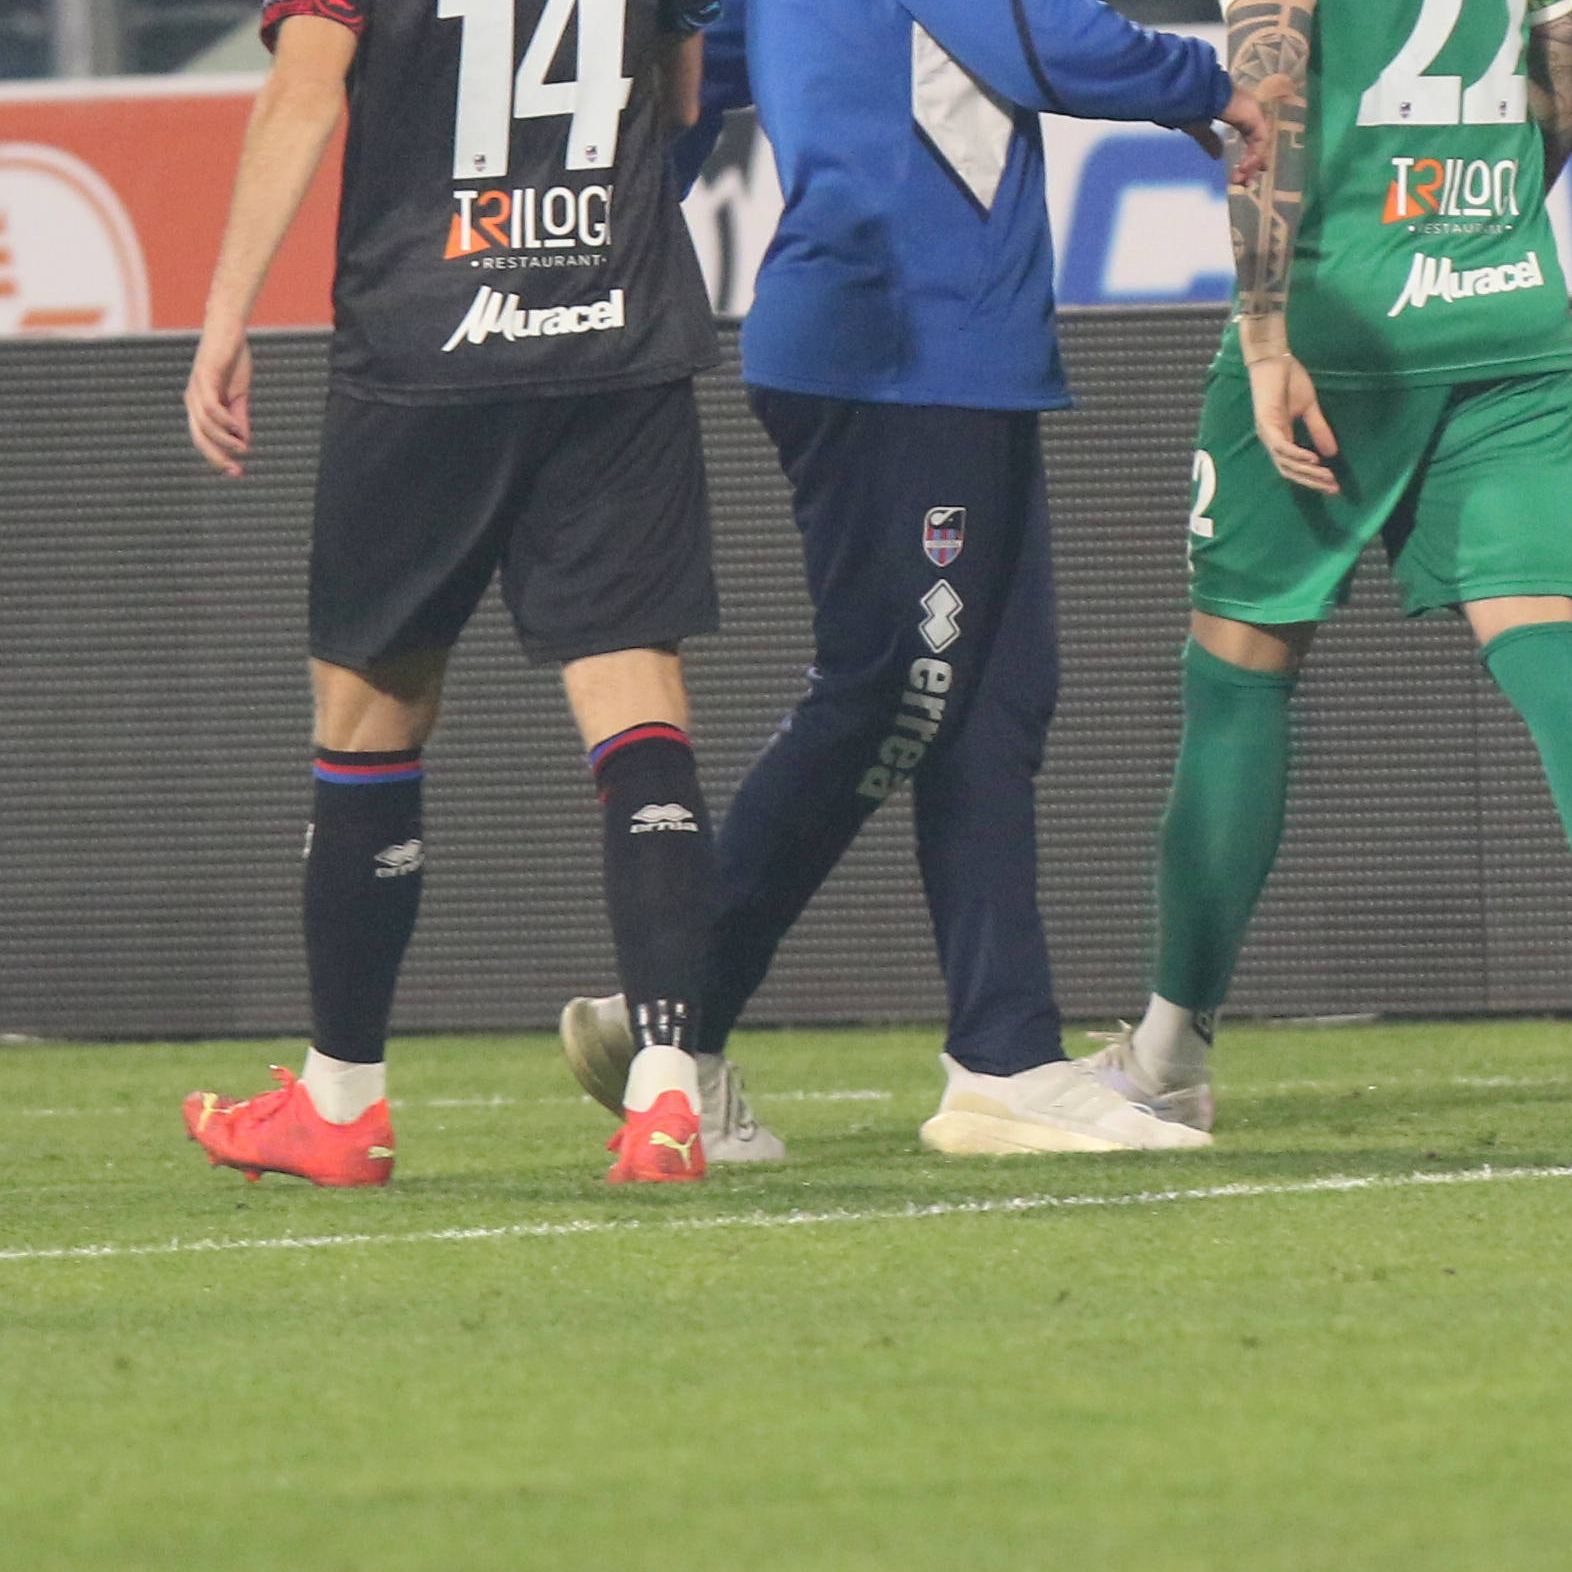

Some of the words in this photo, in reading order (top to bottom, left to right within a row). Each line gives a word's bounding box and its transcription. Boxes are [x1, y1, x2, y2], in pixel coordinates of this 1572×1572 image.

[482, 254, 602, 270] RESTAURANT
[1387, 250, 1545, 318] Muracel
[441, 284, 626, 353] Muracel
